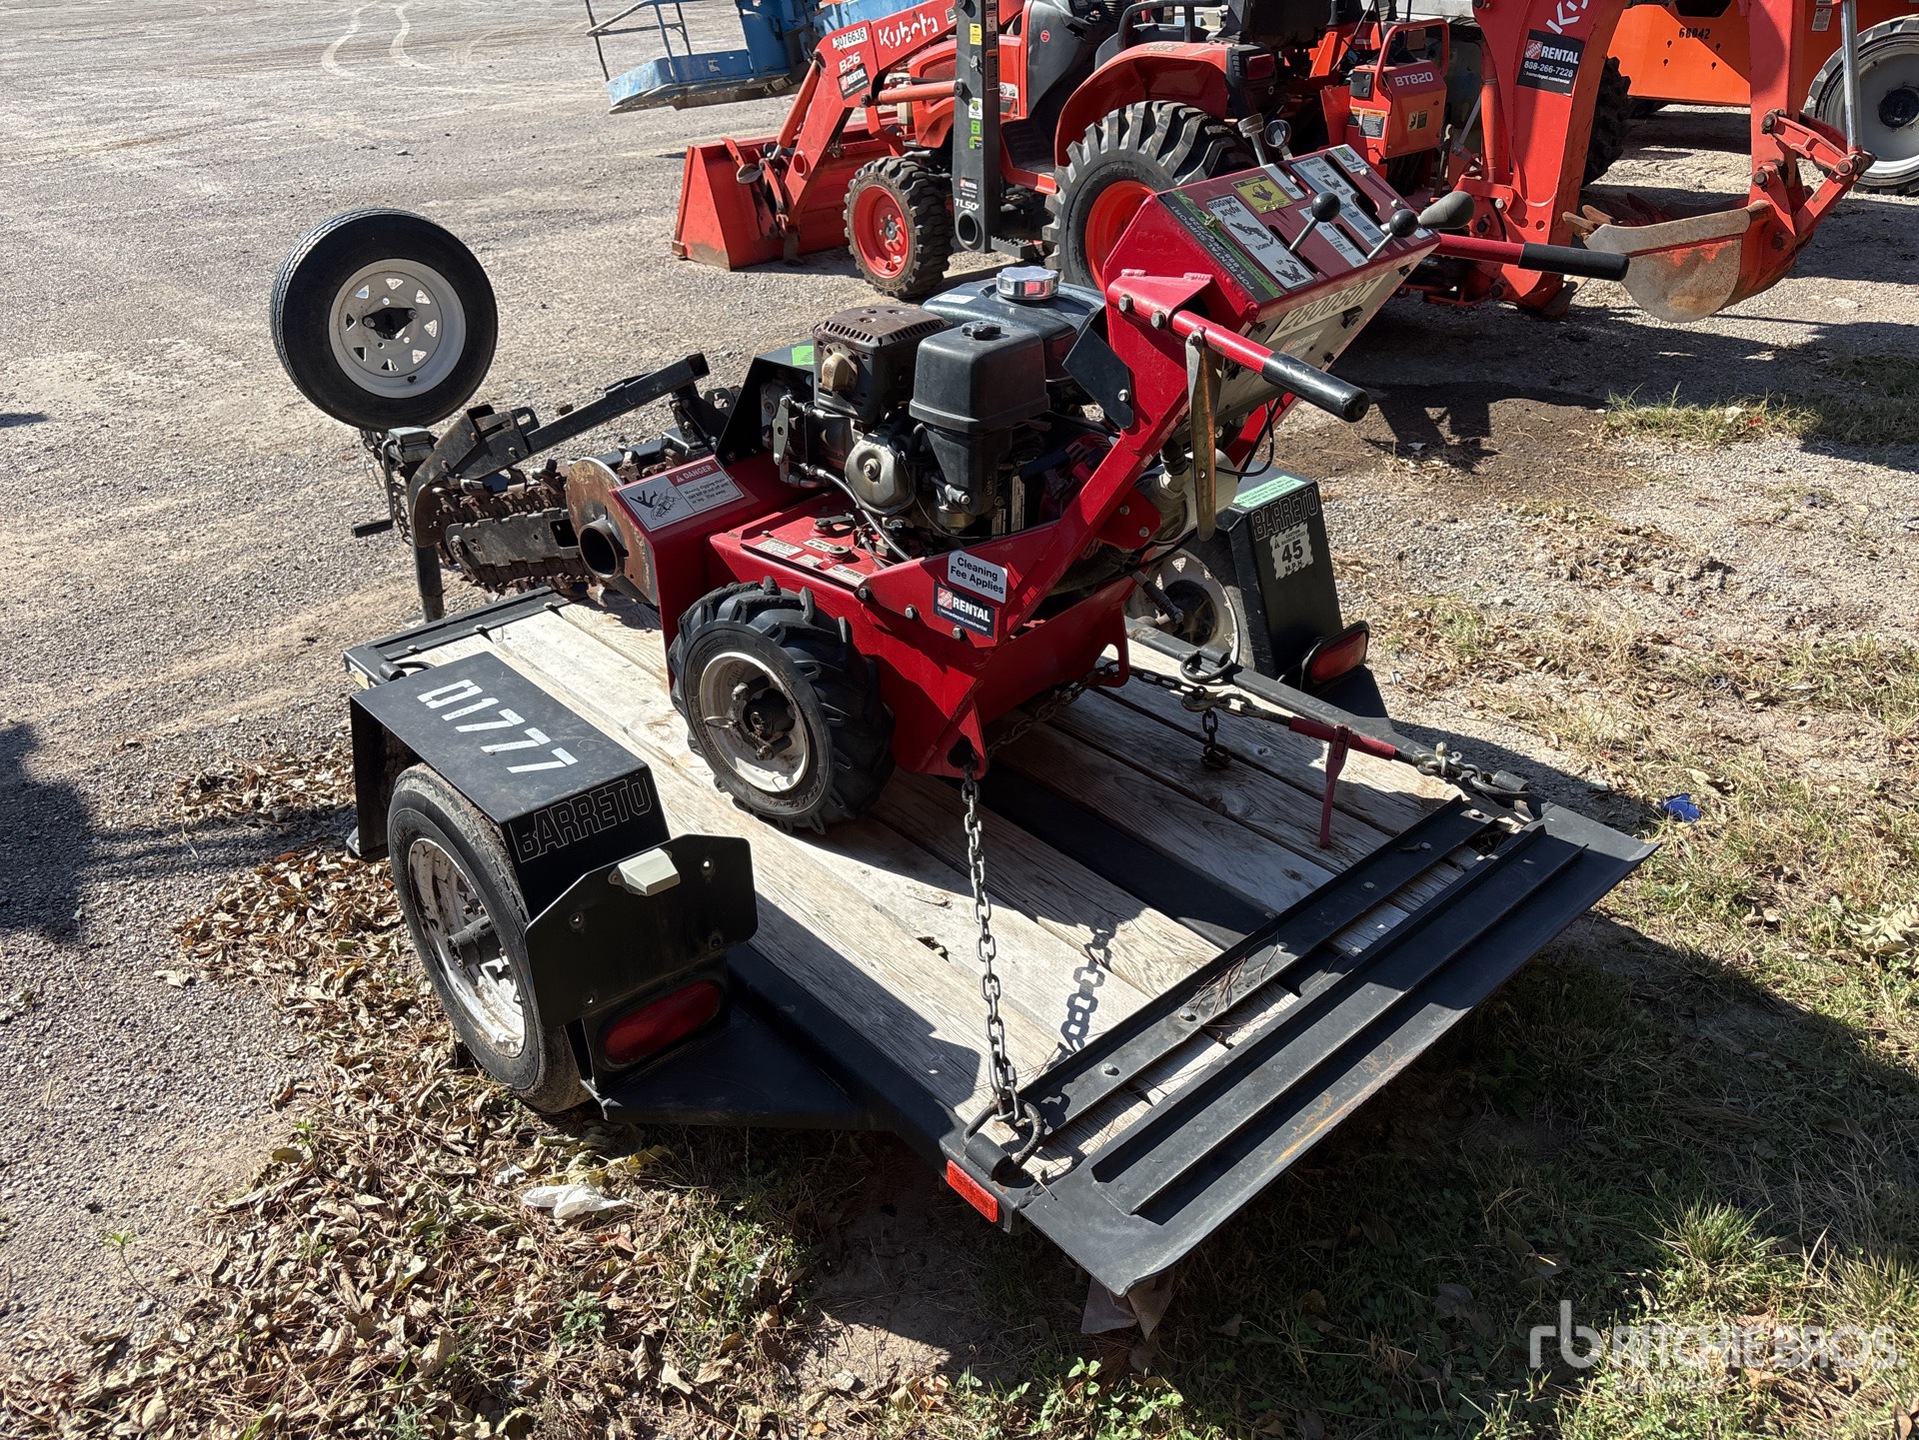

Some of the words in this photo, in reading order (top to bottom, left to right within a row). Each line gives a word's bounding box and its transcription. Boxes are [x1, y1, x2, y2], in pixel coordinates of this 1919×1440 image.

[1678, 28, 1711, 40] 68042
[839, 52, 861, 73] B26
[1541, 46, 1579, 64] RENTAL
[1394, 72, 1434, 87] BT820
[1524, 61, 1574, 78] 888-266-7228
[1207, 197, 1237, 210] DIGGING
[1169, 203, 1207, 242] SUPPORT
[1206, 241, 1240, 276] RENTAL
[1235, 271, 1254, 291] FOR
[1277, 278, 1379, 335] 2800507
[683, 465, 714, 479] DANGER
[1252, 486, 1321, 542] BARRETO
[1281, 540, 1304, 564] 45
[957, 557, 998, 582] Cleaning
[1285, 560, 1304, 572] M.P.H.
[950, 565, 967, 580] Fee
[969, 573, 1004, 594] Applies
[953, 596, 991, 623] RENTAL
[417, 679, 578, 774] 01777
[509, 775, 652, 864] BARRETO
